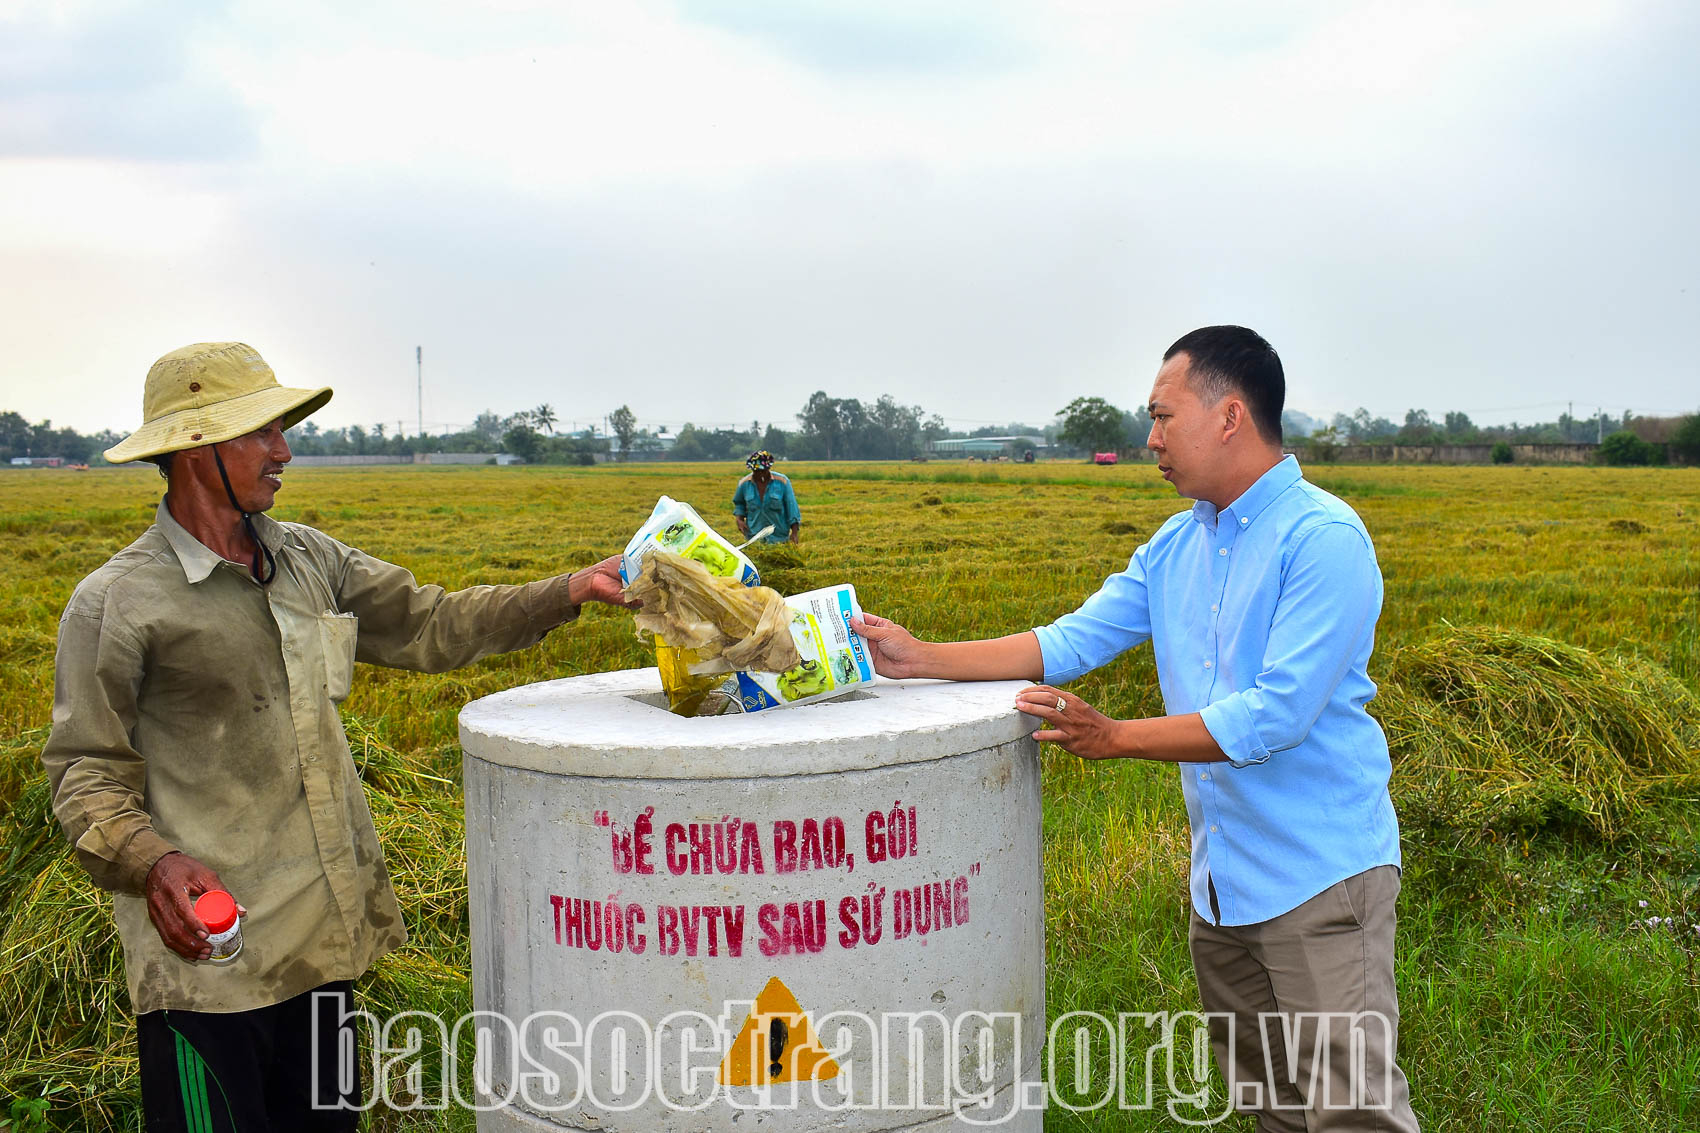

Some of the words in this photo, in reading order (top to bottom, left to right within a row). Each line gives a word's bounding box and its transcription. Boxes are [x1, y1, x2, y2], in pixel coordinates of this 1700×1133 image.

[665, 814, 765, 876] CHỨA
[774, 815, 855, 874] BAO,
[549, 889, 647, 955] THUỐC
[657, 904, 745, 958] BVTV
[757, 899, 828, 957] SAU
[838, 881, 886, 950] SỬ
